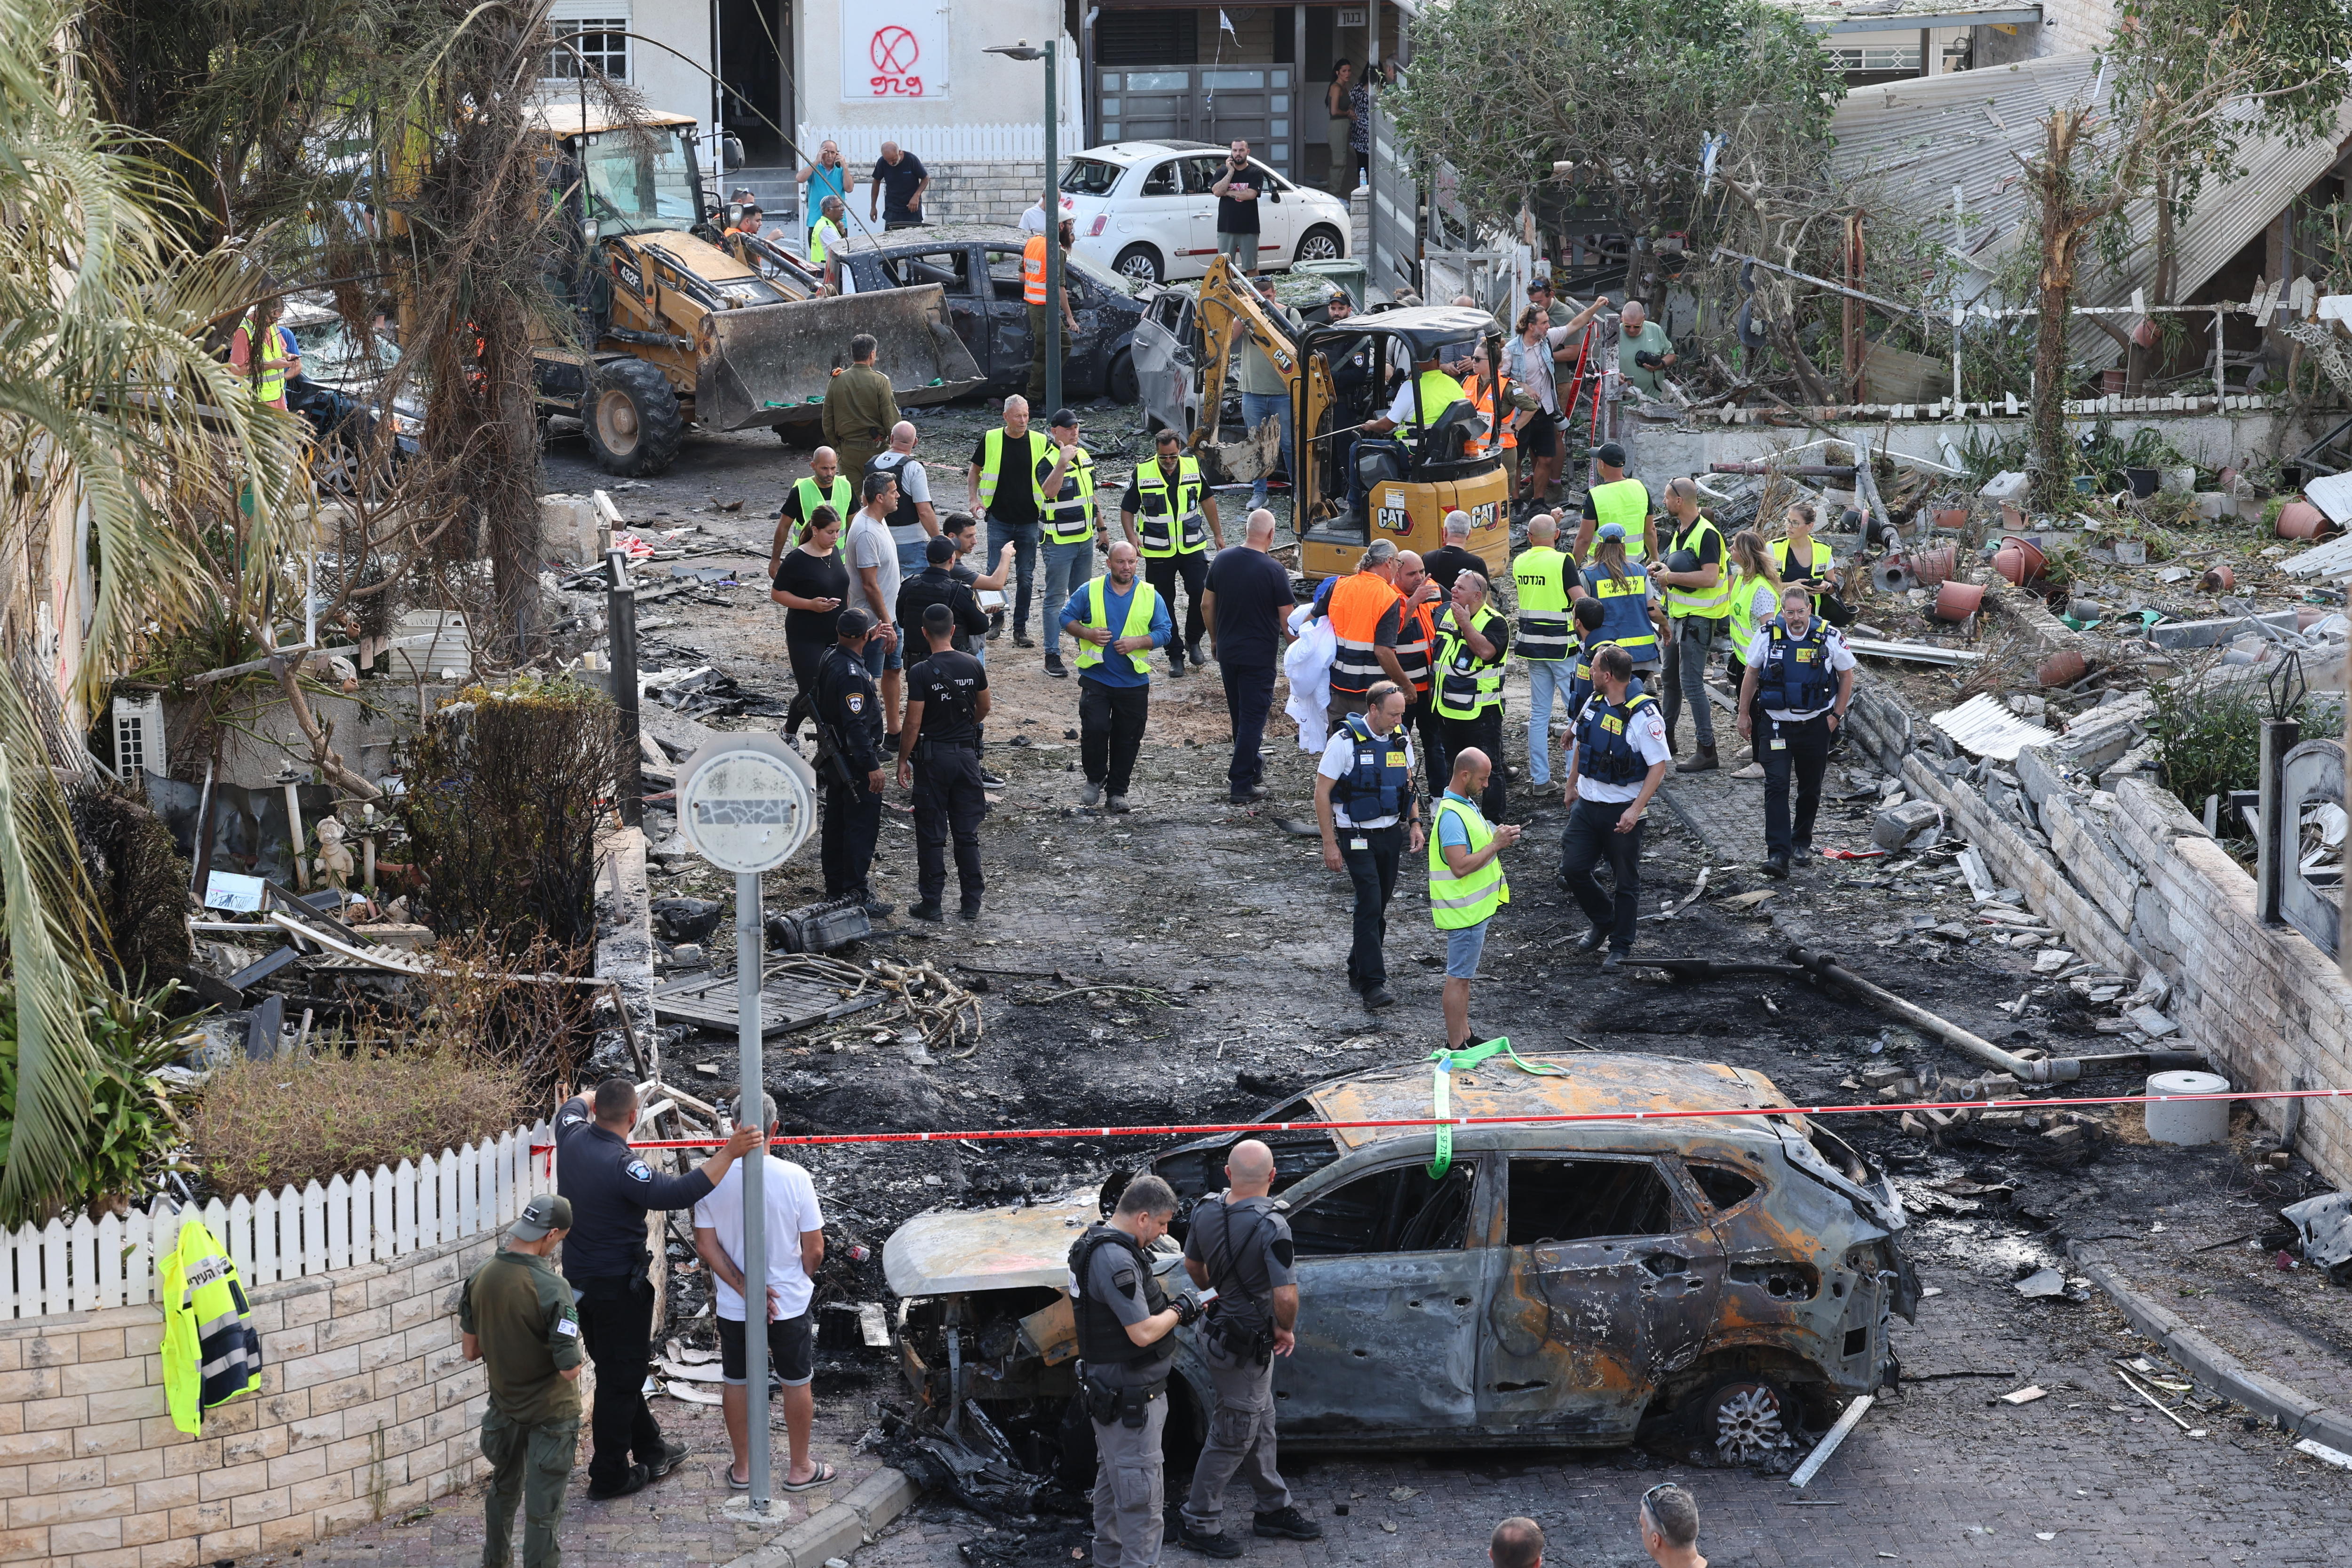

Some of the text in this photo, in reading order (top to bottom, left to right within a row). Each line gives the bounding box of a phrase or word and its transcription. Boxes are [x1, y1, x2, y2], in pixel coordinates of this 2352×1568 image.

[1343, 12, 1361, 24] בנון
[1378, 507, 1405, 530] CAT
[1471, 502, 1495, 528] CAT
[1518, 575, 1545, 586] הנדסה
[1440, 1135, 1447, 1144] SF
